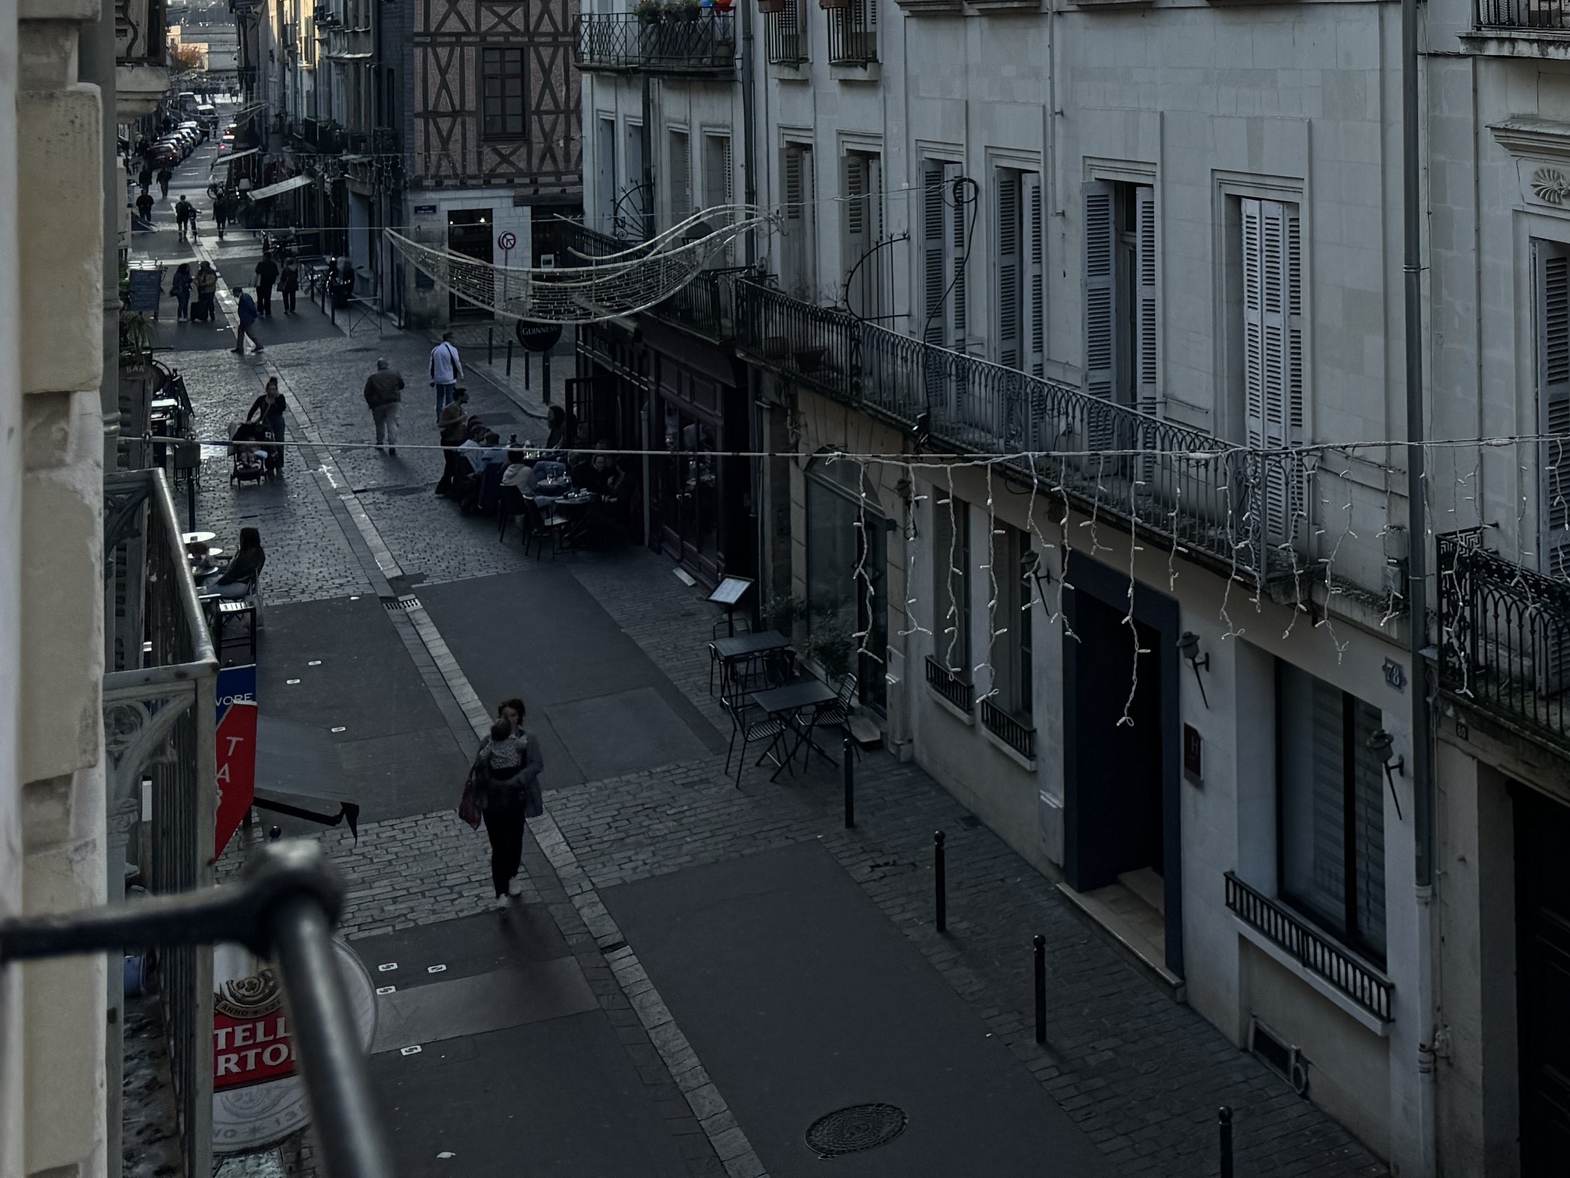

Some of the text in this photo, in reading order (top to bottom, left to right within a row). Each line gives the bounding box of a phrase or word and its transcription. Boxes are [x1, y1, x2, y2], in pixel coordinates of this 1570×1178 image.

[522, 325, 558, 336] GUINNESS
[1386, 663, 1400, 685] 78
[216, 692, 253, 707] VORE
[213, 1016, 294, 1051] TELL
